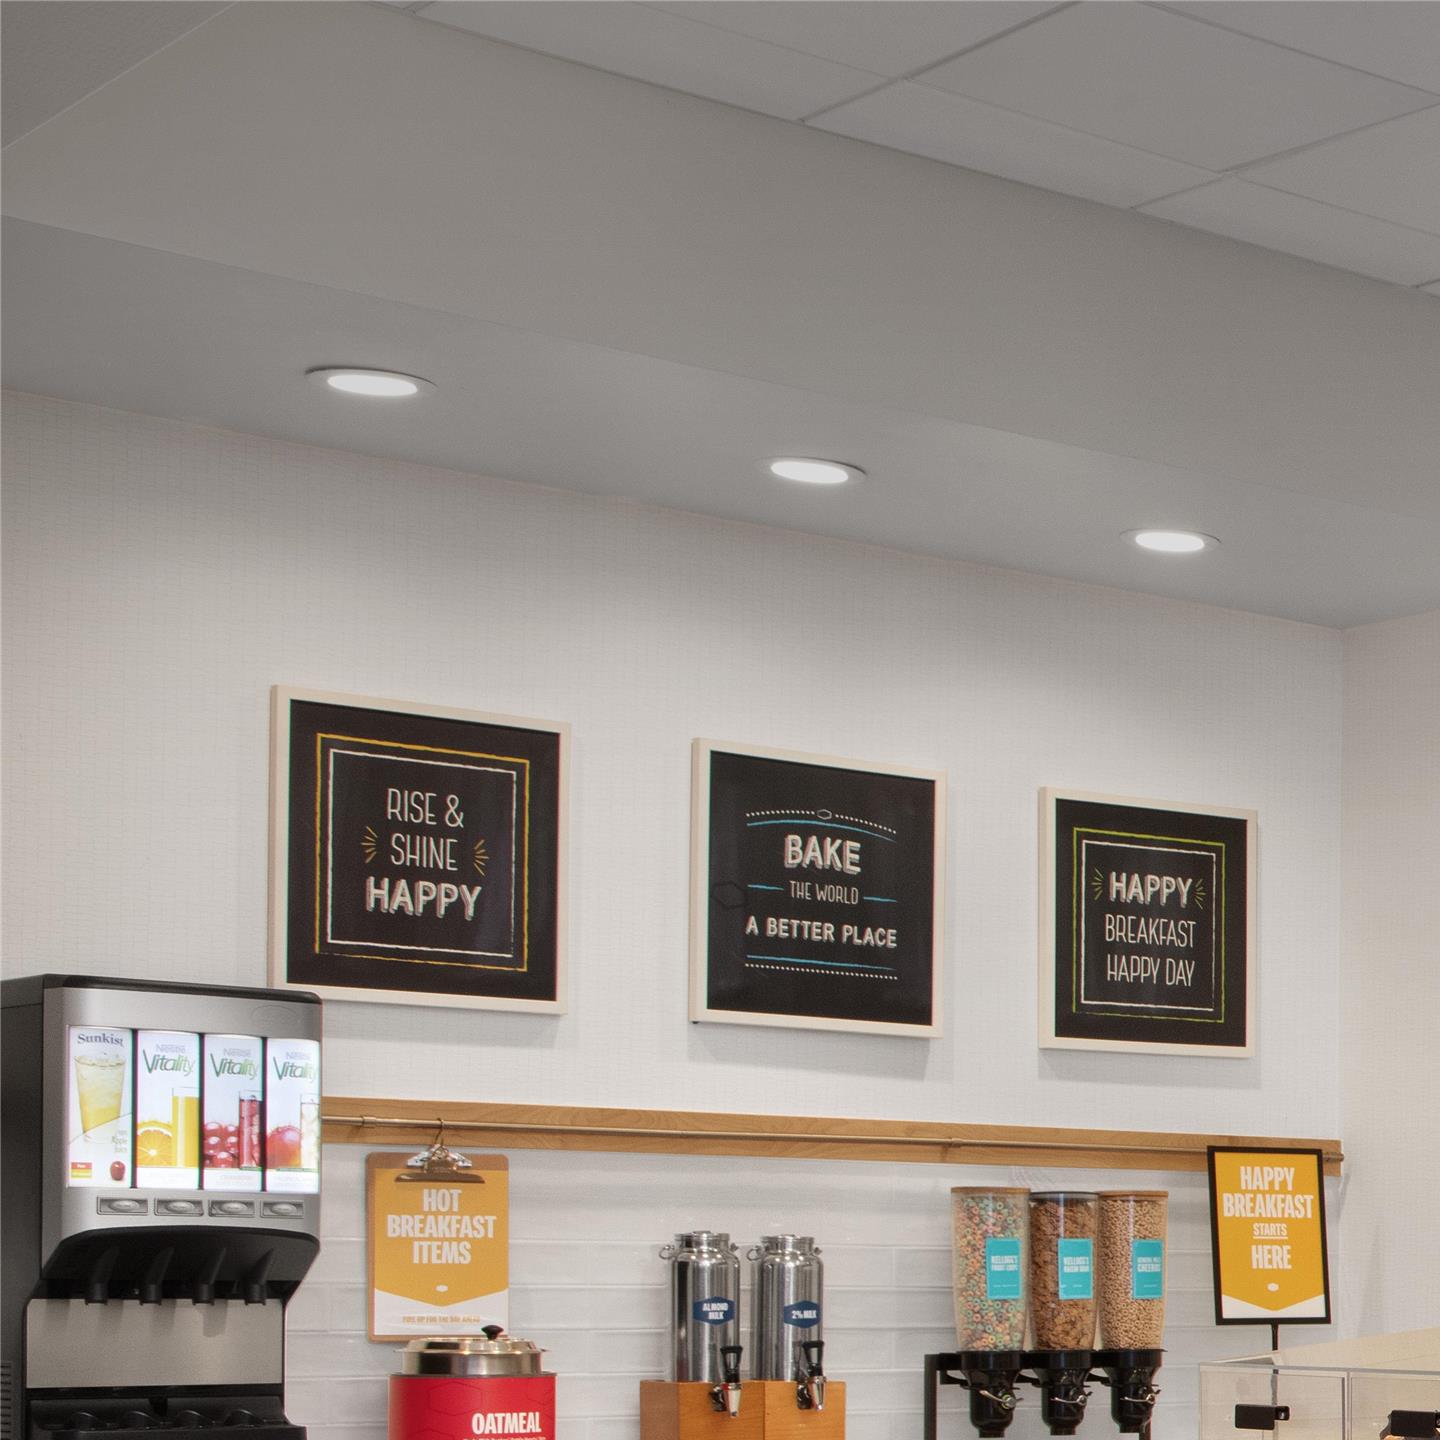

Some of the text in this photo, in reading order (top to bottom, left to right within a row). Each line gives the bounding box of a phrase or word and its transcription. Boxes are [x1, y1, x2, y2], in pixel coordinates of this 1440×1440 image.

[387, 788, 464, 828] RISE &
[390, 833, 458, 871] SHINE
[784, 834, 862, 875] BAKE
[366, 876, 482, 921] HAPPY
[789, 880, 859, 905] THE WORLD
[1110, 871, 1193, 909] HAPPY
[745, 915, 898, 949] A BETTER PLACE
[1105, 913, 1197, 948] BREAKFAST
[1107, 953, 1195, 987] HAPPY DAY
[76, 1032, 124, 1048] Sunkist
[142, 1049, 195, 1078] Vitality
[209, 1053, 258, 1081] Vitality
[1239, 1166, 1295, 1191] HAPPY
[423, 1188, 462, 1212] HOT
[1222, 1193, 1314, 1219] BREAKFAST
[387, 1214, 496, 1238] BREAKFAST
[1253, 1223, 1288, 1236] STARTS
[413, 1241, 472, 1264] ITEMS
[1251, 1245, 1292, 1269] HERE
[472, 1412, 542, 1434] OATMEAL
